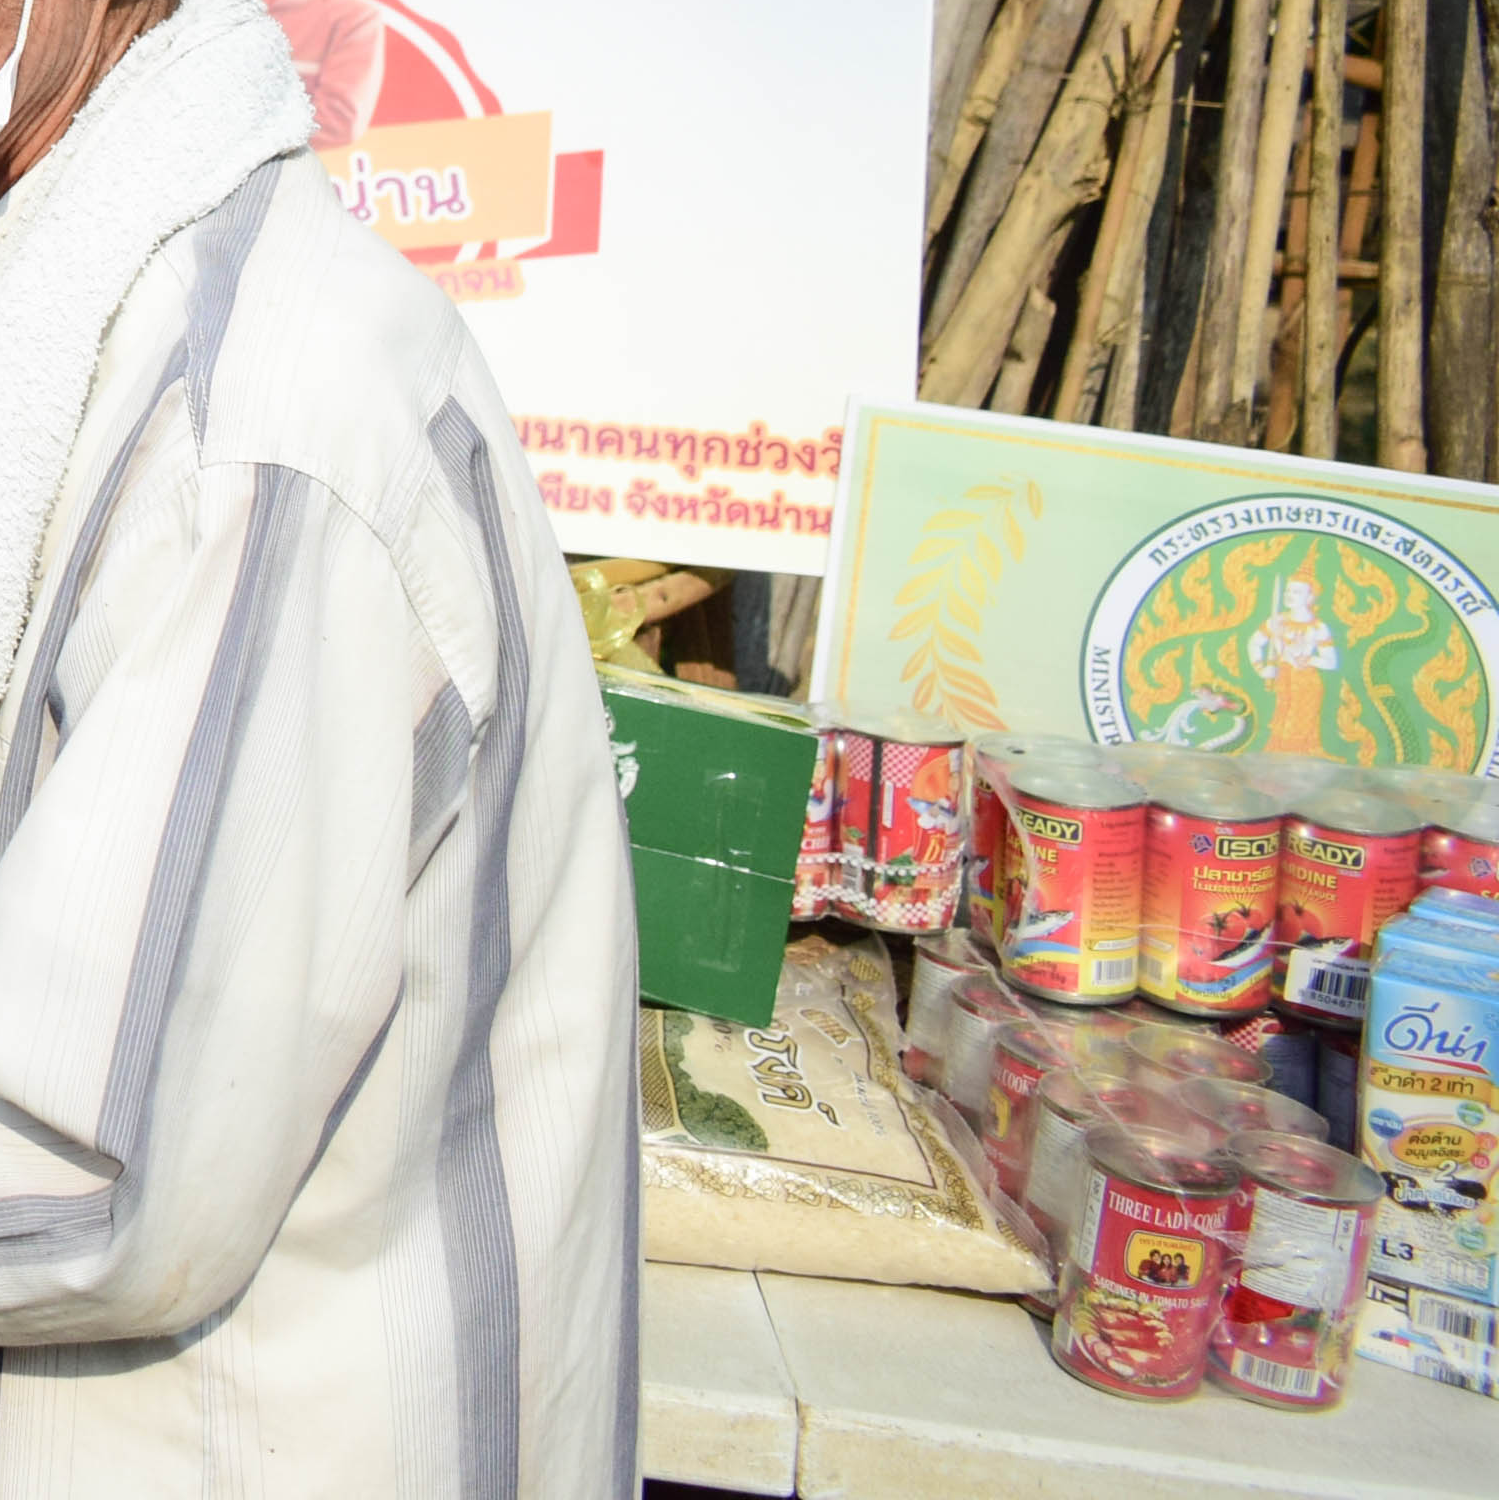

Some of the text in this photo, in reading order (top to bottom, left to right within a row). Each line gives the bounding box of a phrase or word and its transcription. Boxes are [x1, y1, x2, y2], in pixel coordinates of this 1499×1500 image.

[626, 480, 832, 534] จังหวัดน่าน
[1148, 505, 1494, 617] กระทรวงเกษตรและสหกรณ์
[1288, 834, 1361, 866] READY
[1384, 1001, 1488, 1062] ดีน่า
[1382, 1071, 1474, 1095] งาดำ 2 เท่า
[1408, 1131, 1462, 1147] ต่อต้าน
[1434, 1159, 1457, 1183] 2
[1107, 1190, 1153, 1224] THREE
[1154, 1207, 1194, 1231] LADY
[1380, 1237, 1414, 1261] L3
[1093, 1273, 1137, 1301] SARDINES
